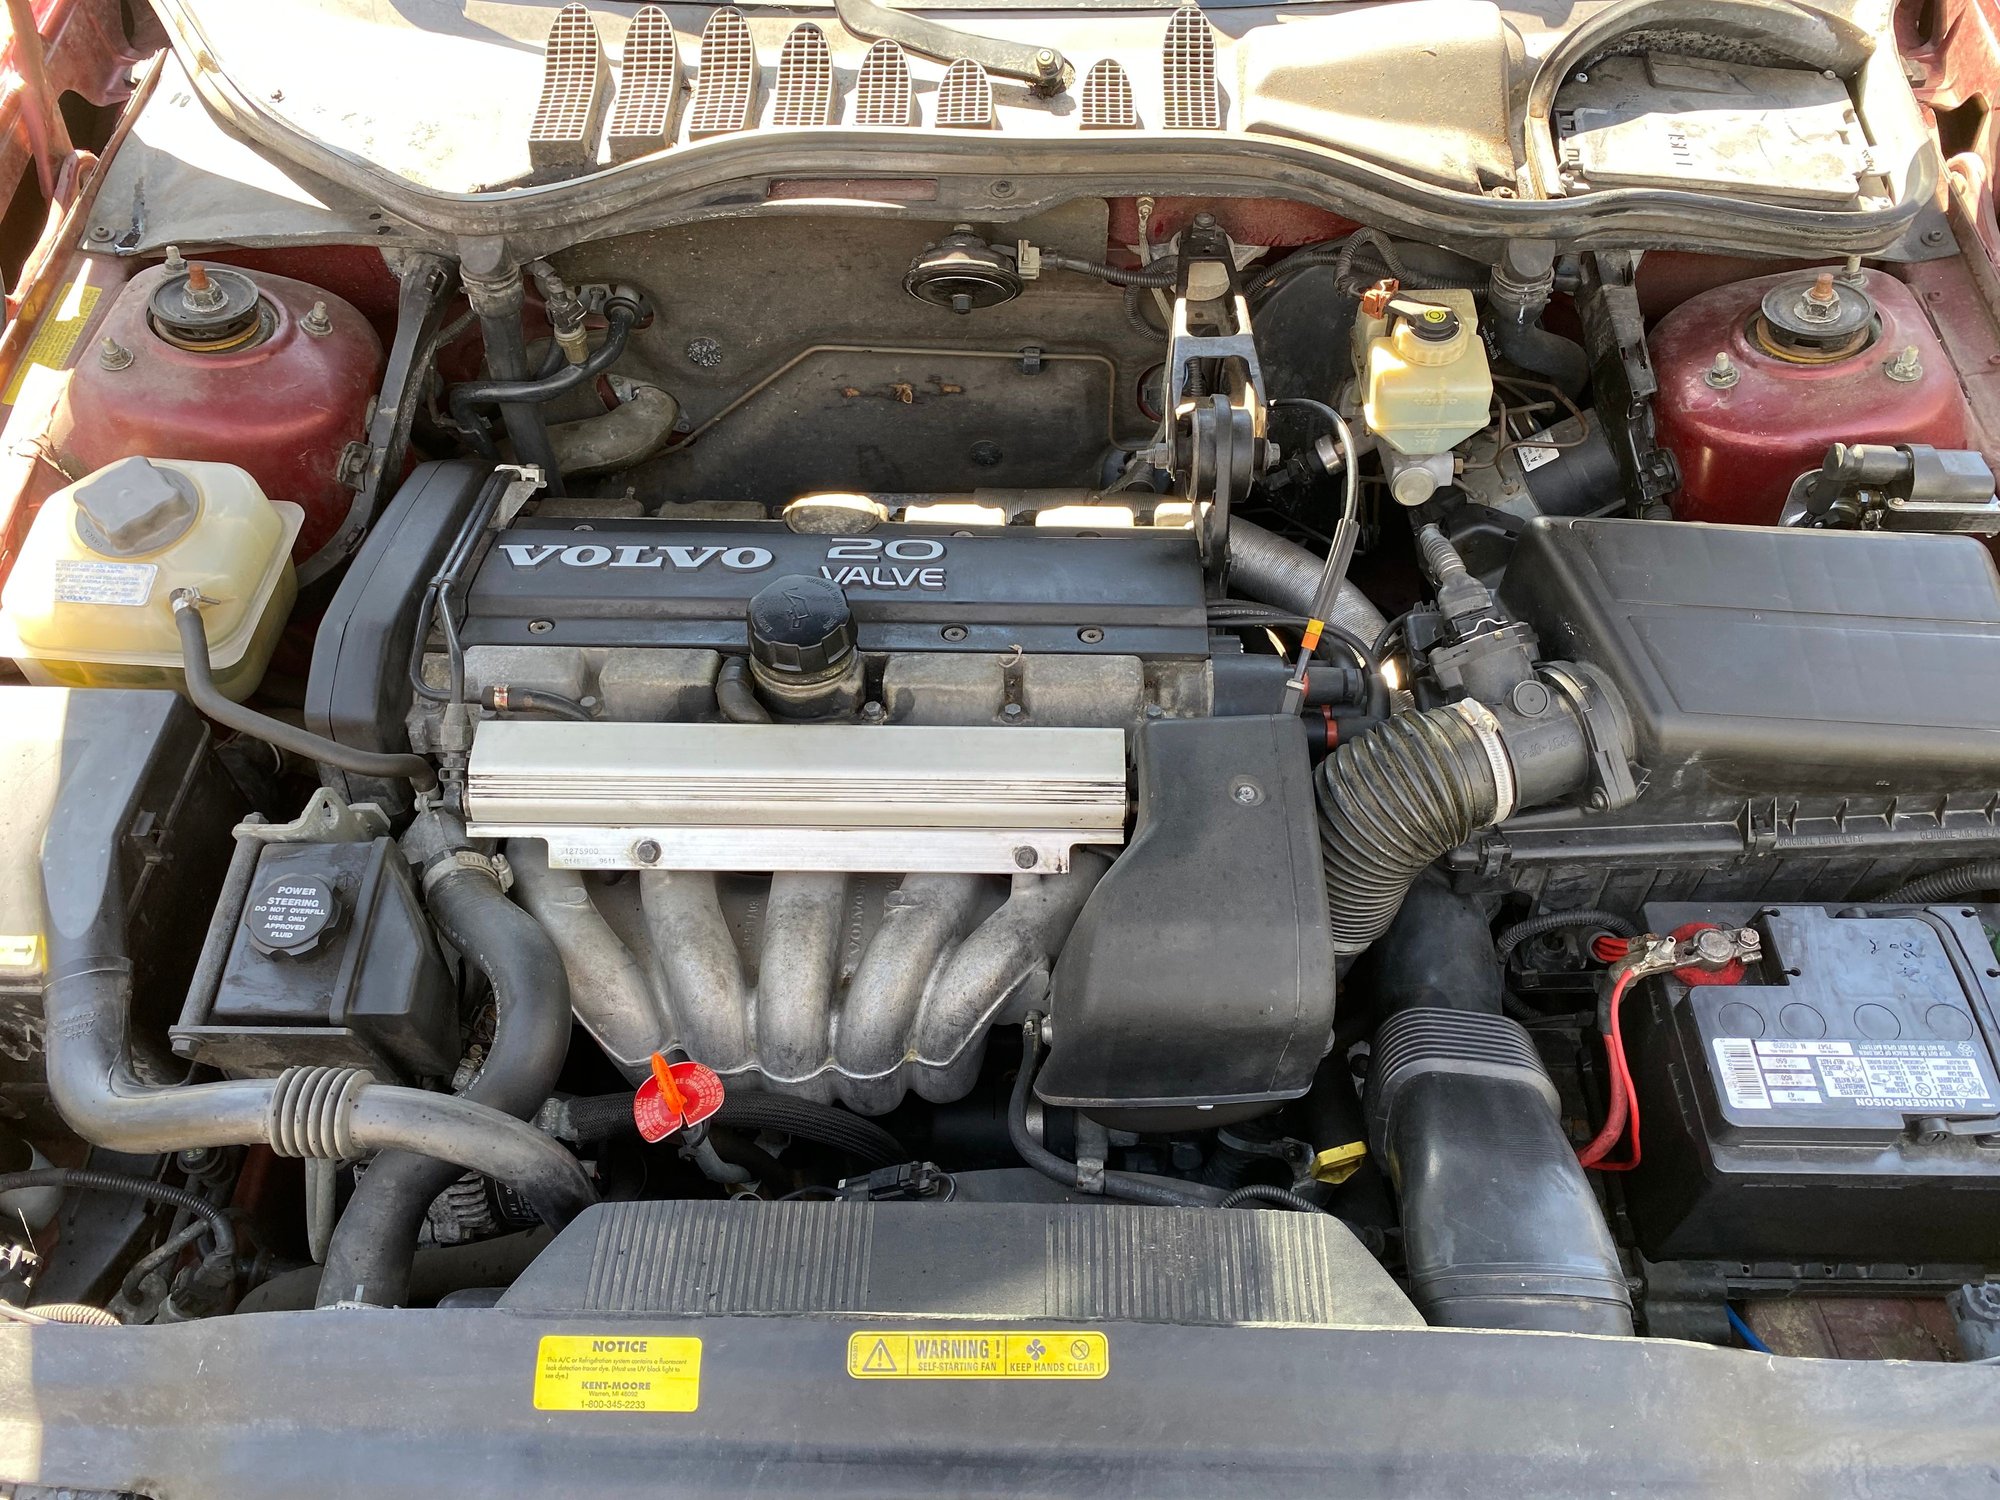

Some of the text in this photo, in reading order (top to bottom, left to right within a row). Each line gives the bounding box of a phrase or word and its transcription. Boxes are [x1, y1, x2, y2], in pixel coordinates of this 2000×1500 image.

[826, 538, 946, 562] 20
[498, 544, 774, 572] VOLVO
[821, 566, 946, 590] VALVE
[278, 886, 316, 896] POWER
[267, 897, 320, 907] STEERING
[264, 923, 306, 931] APPROVED
[695, 1064, 712, 1077] NOTE
[711, 1077, 720, 1089] OIL
[1855, 1098, 1954, 1107] DANGER/POISON
[593, 1341, 647, 1352] NOTICE
[914, 1339, 1000, 1359] WARNING !
[662, 1366, 674, 1374] light
[918, 1362, 996, 1371] SELF-STARTING FAN
[1010, 1363, 1031, 1372] KEEP
[1034, 1363, 1065, 1372] HANDS
[1068, 1363, 1095, 1372] CLEAR
[582, 1381, 650, 1390] KENT-MOORE
[581, 1400, 645, 1409] 1-800-345-2233
